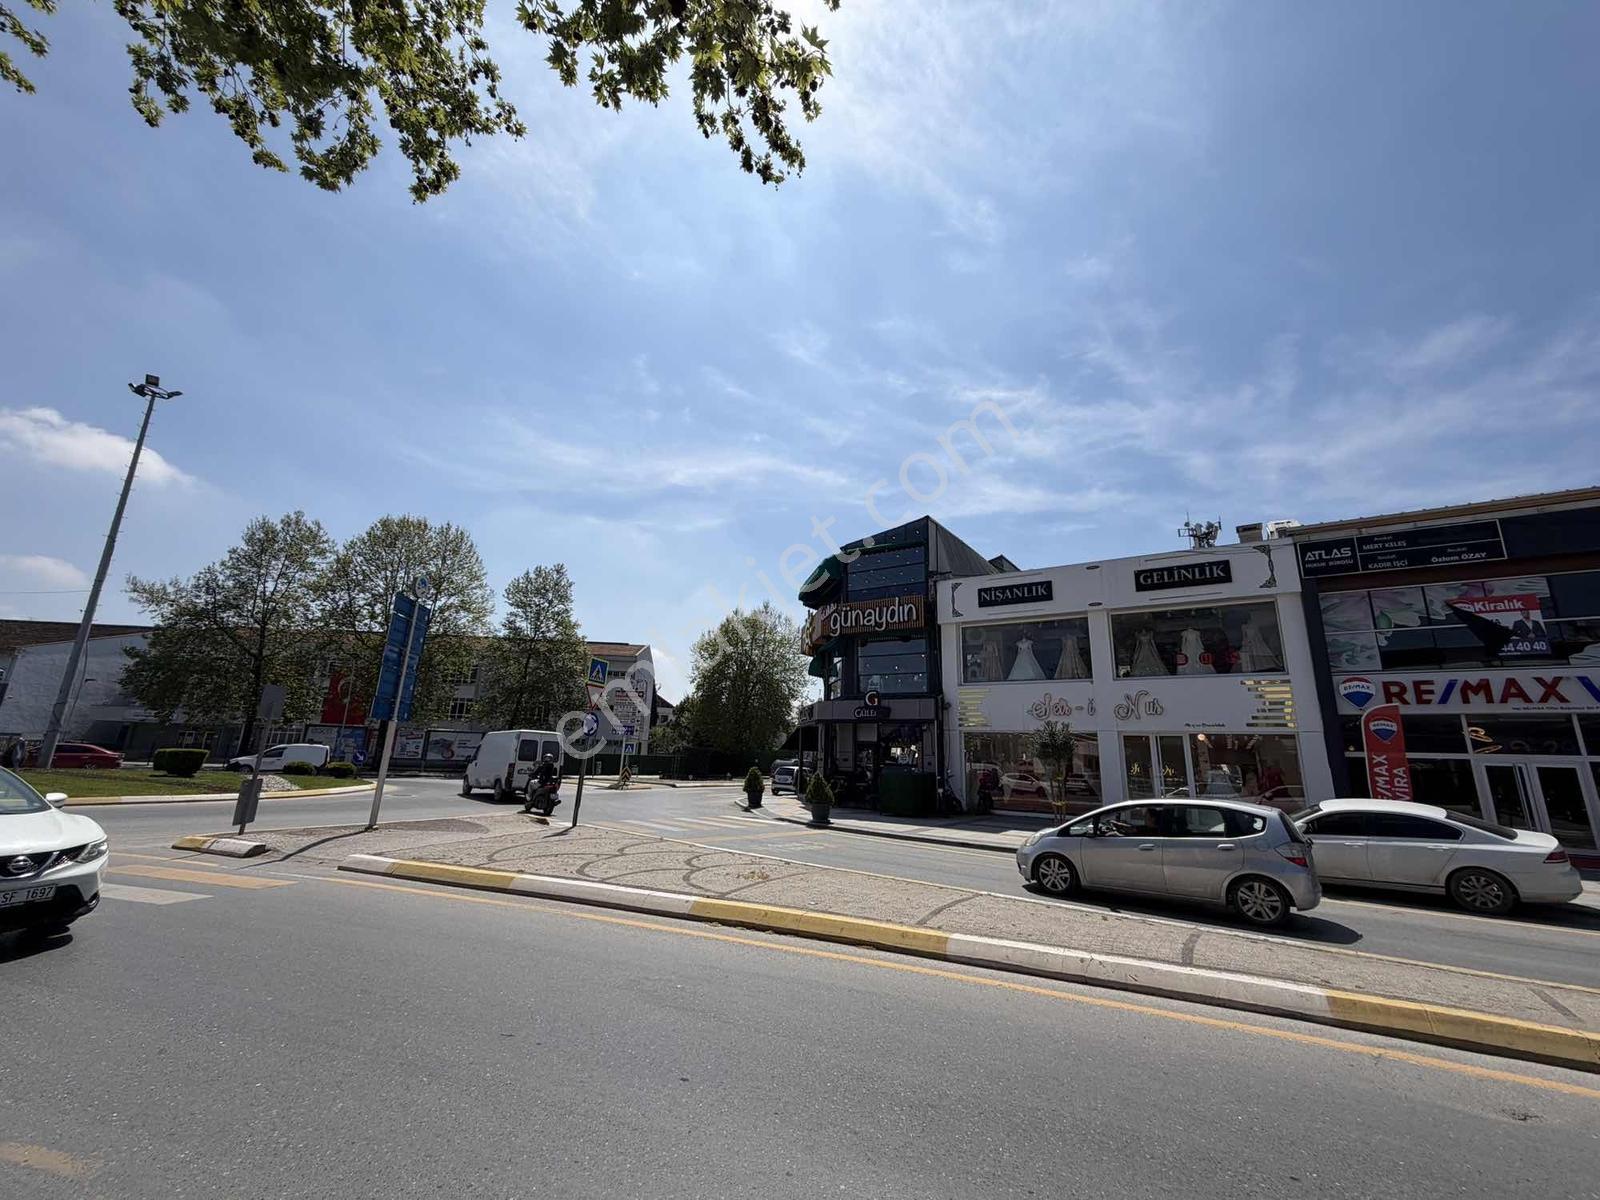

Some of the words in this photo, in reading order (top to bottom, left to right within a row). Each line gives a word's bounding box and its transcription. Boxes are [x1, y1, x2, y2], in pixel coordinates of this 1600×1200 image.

[1305, 547, 1352, 561] ATLAS
[1139, 564, 1226, 585] GELİNLİK
[980, 583, 1048, 602] NİŞANLIK
[1474, 599, 1525, 612] Kiralık
[830, 597, 917, 637] günaydın
[1516, 641, 1531, 652] 40
[1533, 641, 1547, 650] 40
[1381, 676, 1570, 705] RE/MAX
[26, 886, 54, 900] 1697
